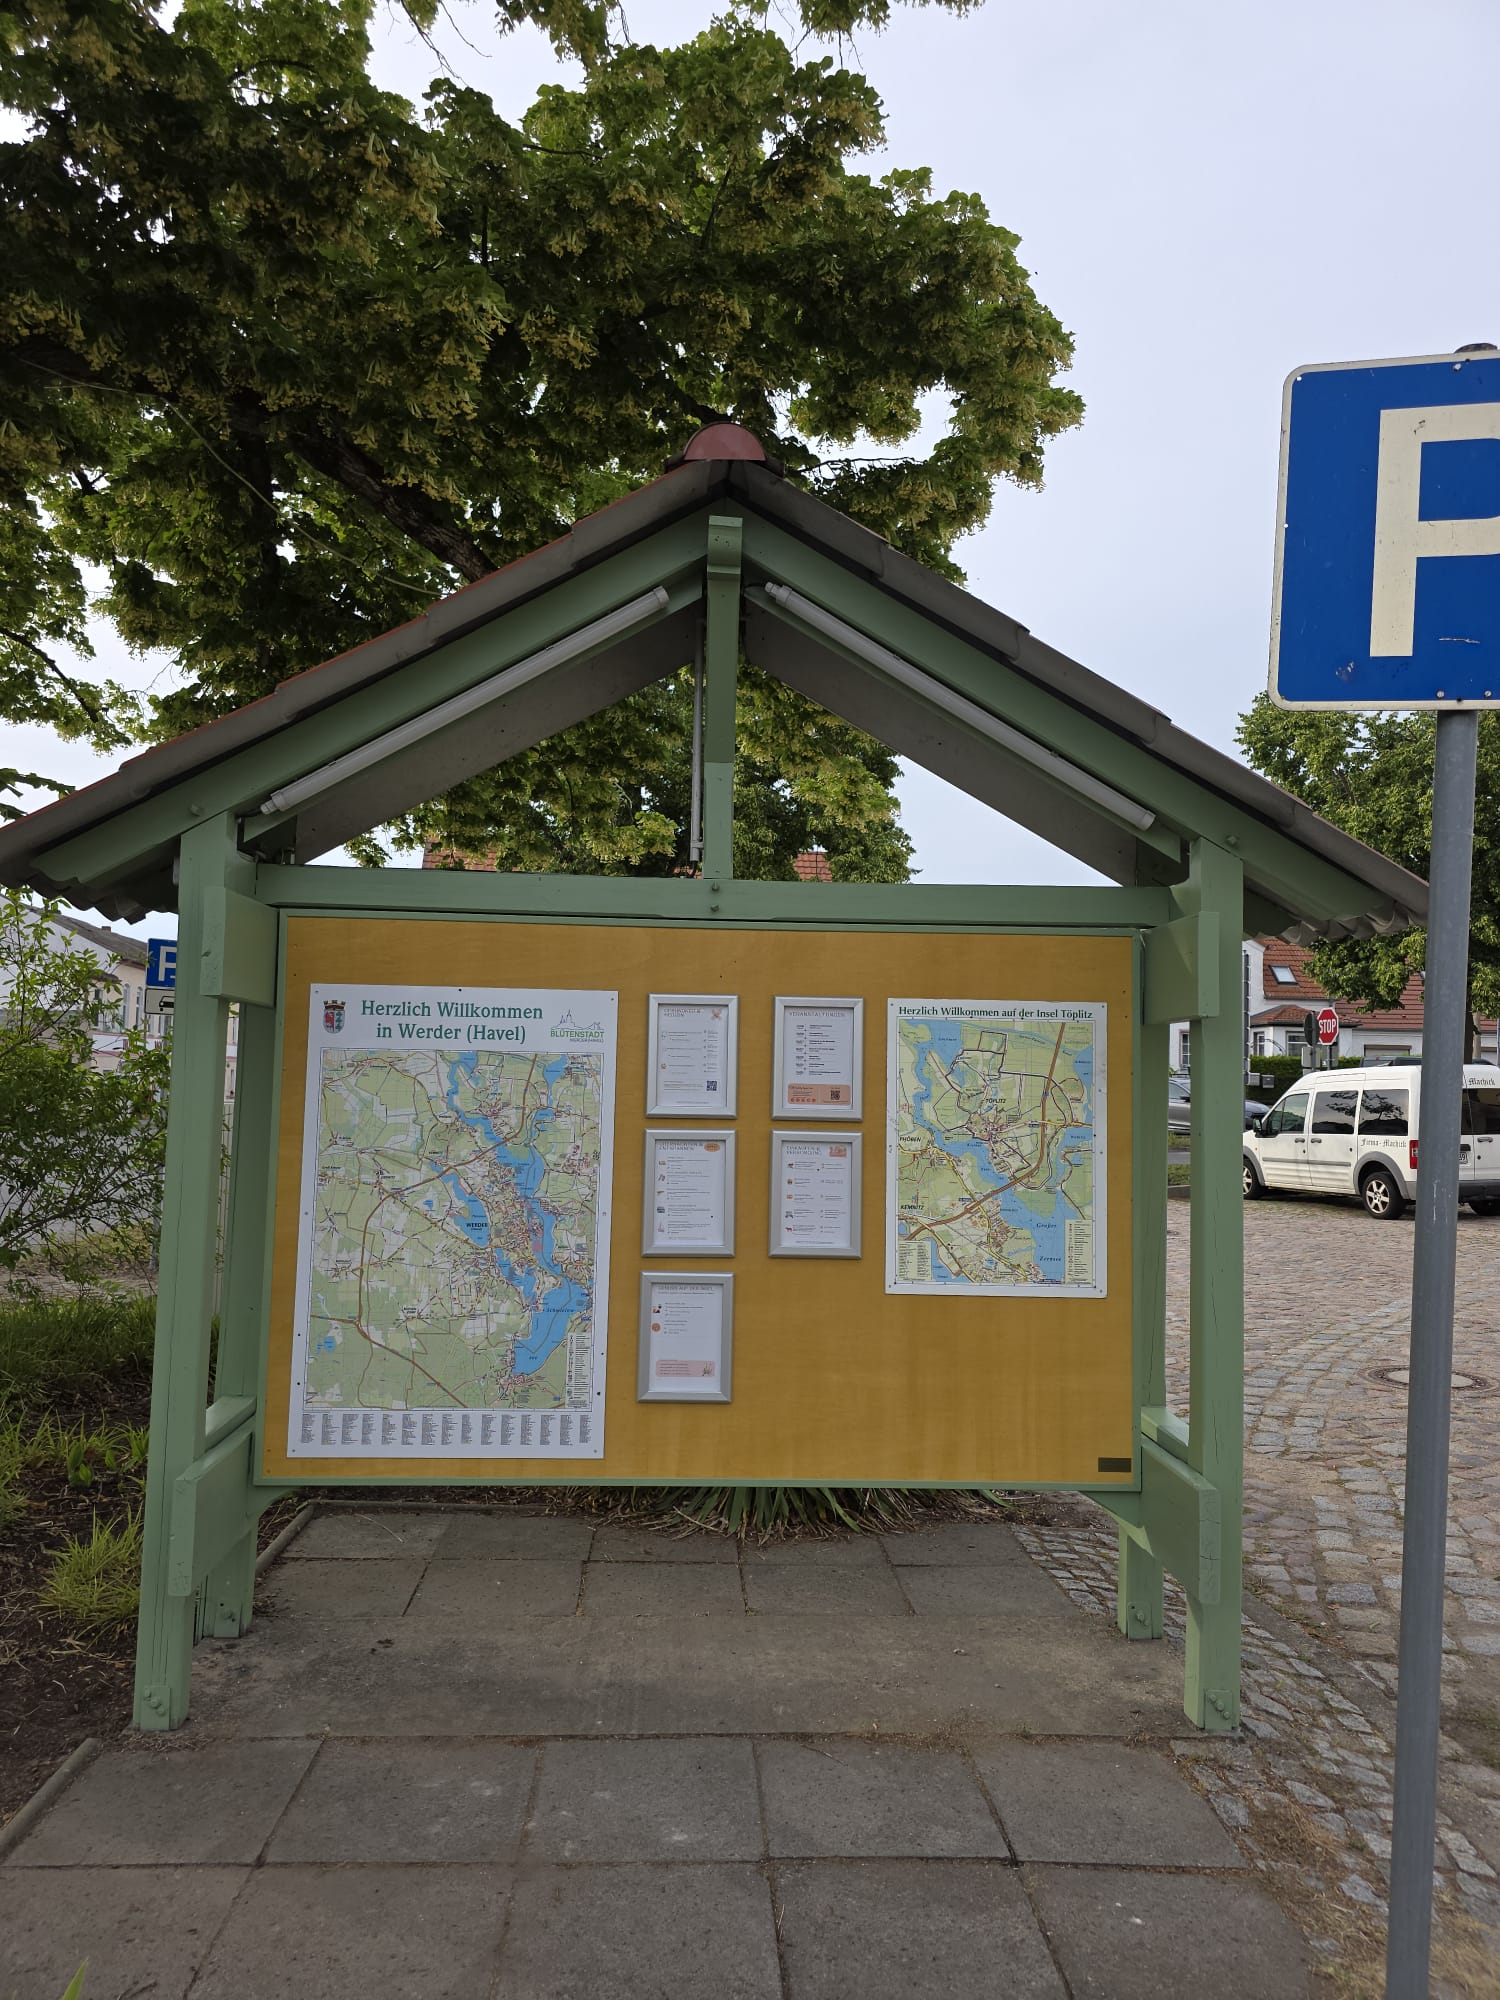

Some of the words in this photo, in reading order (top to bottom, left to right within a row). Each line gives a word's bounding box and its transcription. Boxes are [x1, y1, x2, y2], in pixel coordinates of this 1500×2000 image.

[1370, 402, 1500, 657] P
[361, 1000, 432, 1017] Herzlich
[437, 1002, 543, 1019] Willkommen
[899, 1006, 938, 1016] Herzlich
[941, 1007, 999, 1017] Willkommen
[1002, 1008, 1016, 1017] auf
[1019, 1008, 1034, 1018] der
[1037, 1009, 1058, 1018] Insel
[1060, 1009, 1093, 1020] Töplitz
[376, 1023, 392, 1038] in
[398, 1023, 462, 1039] Werder
[467, 1024, 526, 1045] (Havel)
[1318, 1019, 1337, 1034] STOP
